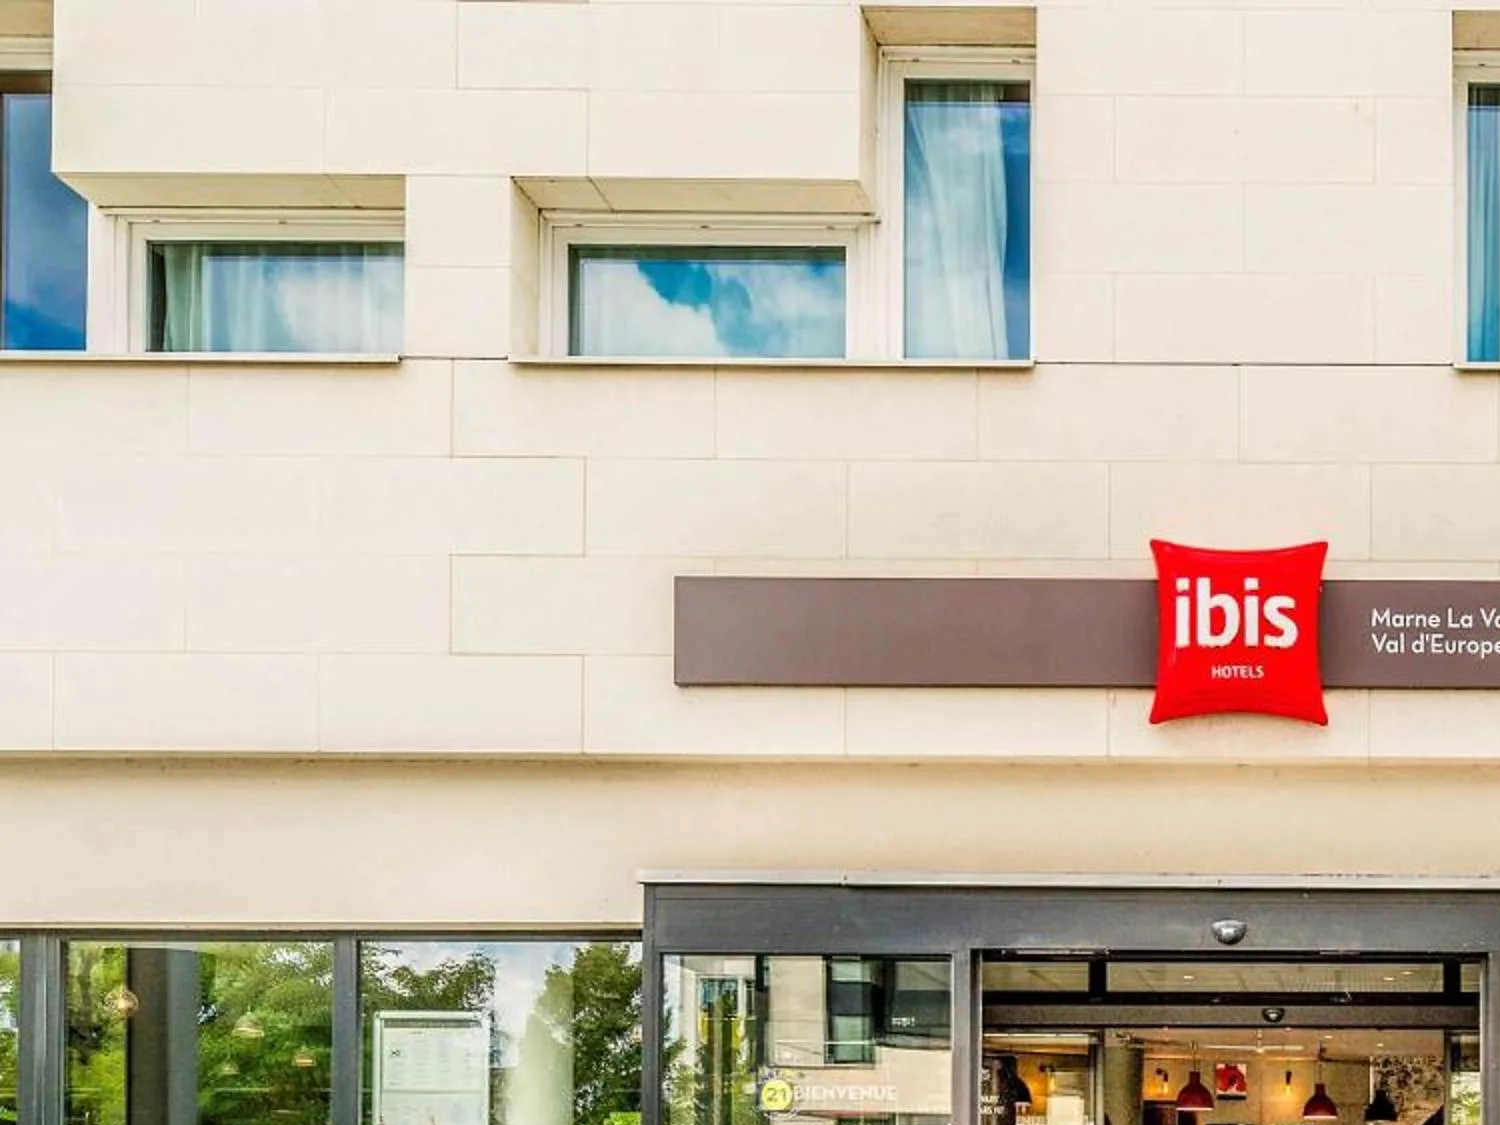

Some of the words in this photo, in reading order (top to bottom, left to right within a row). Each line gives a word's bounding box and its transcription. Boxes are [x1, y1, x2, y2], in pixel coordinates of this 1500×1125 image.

[1175, 577, 1299, 649] ibis
[1371, 607, 1441, 629] Marne
[1447, 608, 1474, 629] La
[1371, 634, 1406, 654] Val
[1211, 665, 1264, 679] HOTELS
[793, 1085, 897, 1101] BIENVENUE
